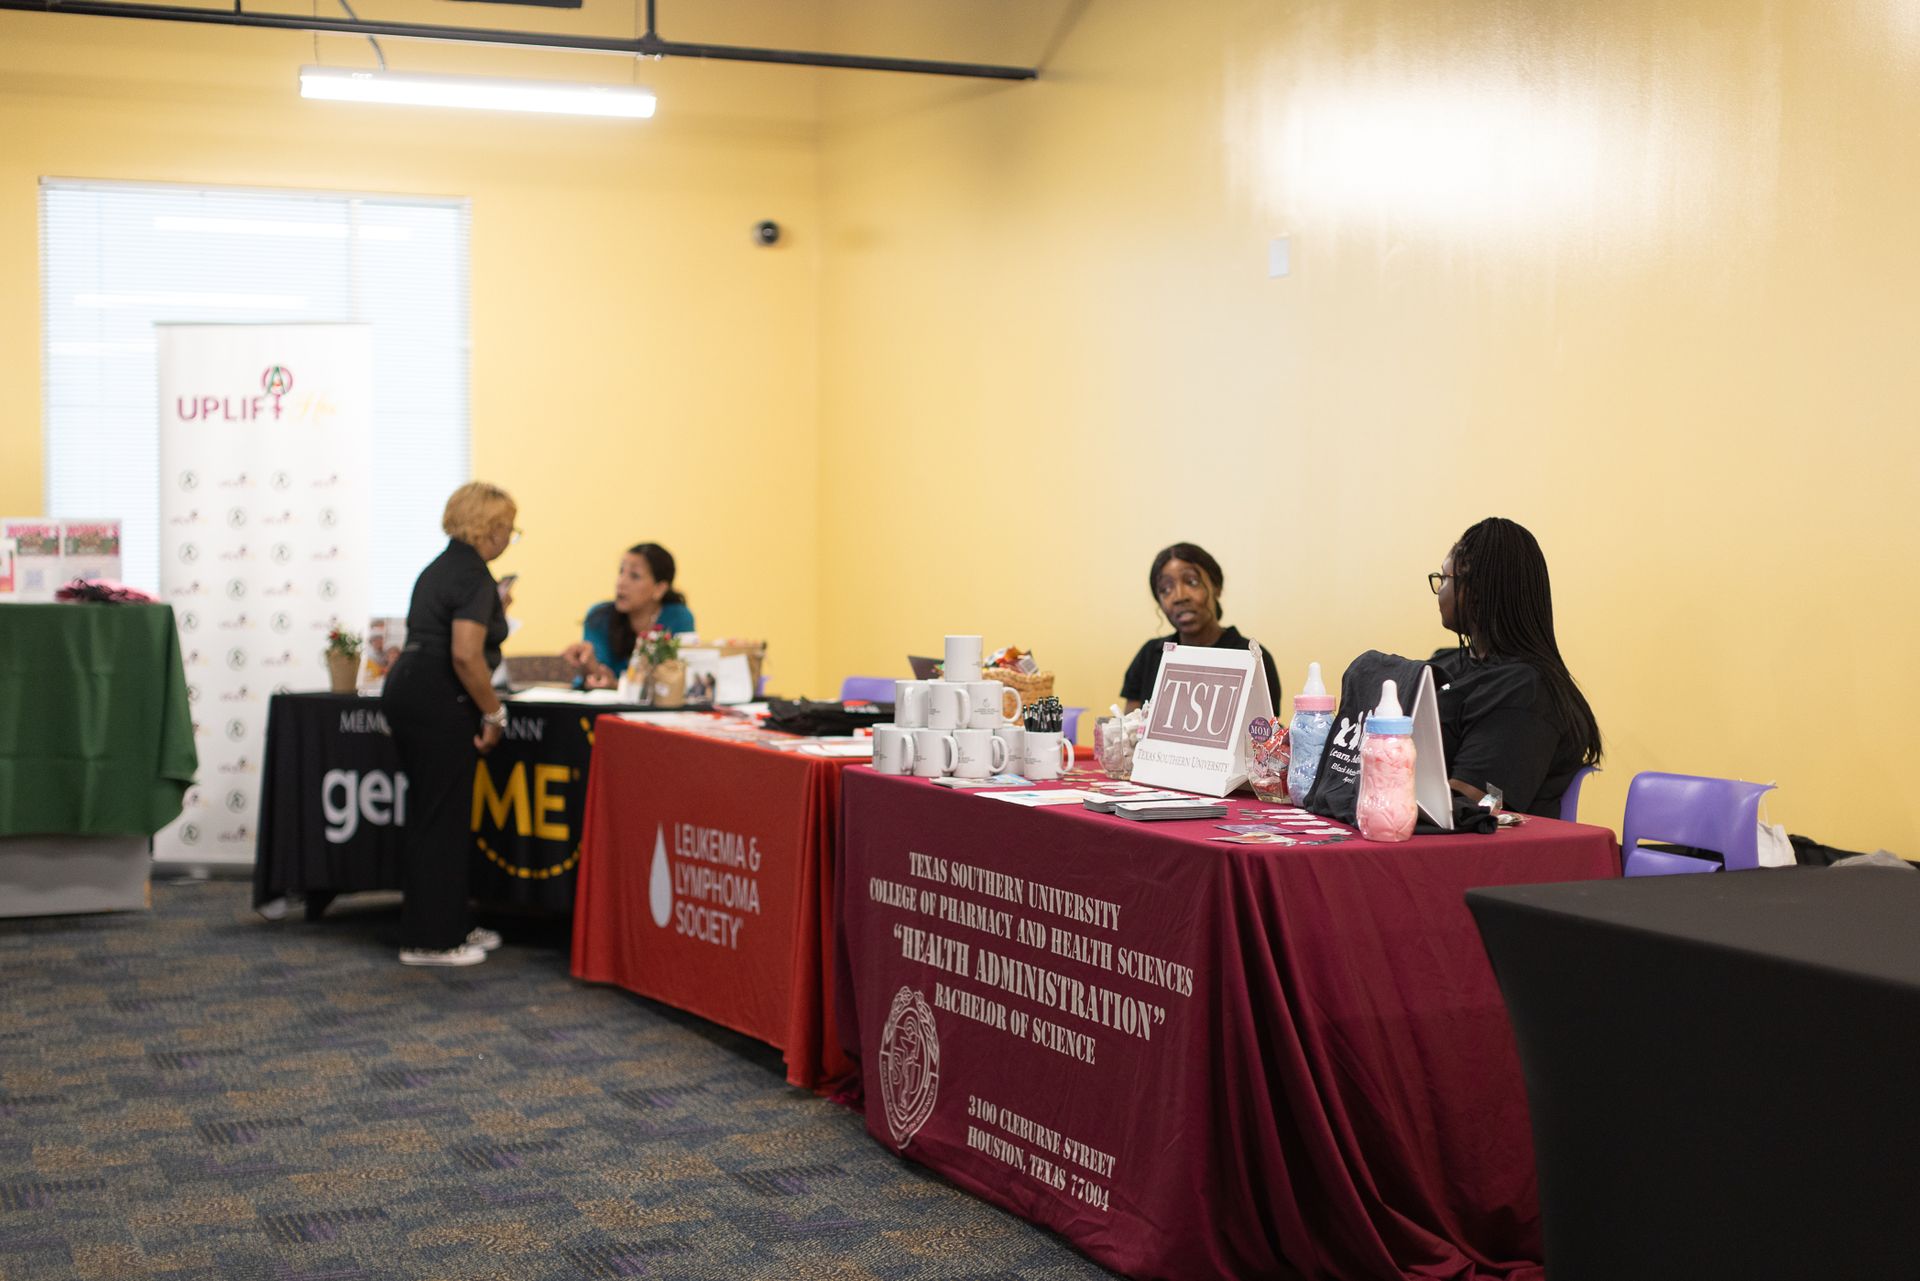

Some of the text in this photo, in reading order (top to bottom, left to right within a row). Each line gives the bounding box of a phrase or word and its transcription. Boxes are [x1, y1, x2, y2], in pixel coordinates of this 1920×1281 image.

[177, 391, 284, 421] UPLIFT
[1163, 679, 1238, 736] TSU
[1251, 725, 1269, 737] MOM
[1137, 748, 1229, 773] TEXAS SOUTHERN UNIVERSITY
[1329, 748, 1351, 762] Learn,
[674, 822, 761, 872] LEUKEMIA &
[674, 861, 761, 915] LYMPHOMA
[909, 851, 1121, 931] TEXAS SOUTHERN UNIVERSITY
[675, 900, 743, 950] SOCIETY
[869, 877, 1194, 998] COLLEGE OF PHARMACY AND HEALTH SCIENCES
[893, 923, 1166, 1041] “HEALTH ADMINISTRATION”
[934, 982, 1096, 1065] BACHELOR OF SCIENCE
[968, 1095, 1116, 1179] 3100 CLEBURNE STREET
[967, 1125, 1110, 1213] HOUSTON, TEXAS 77004
